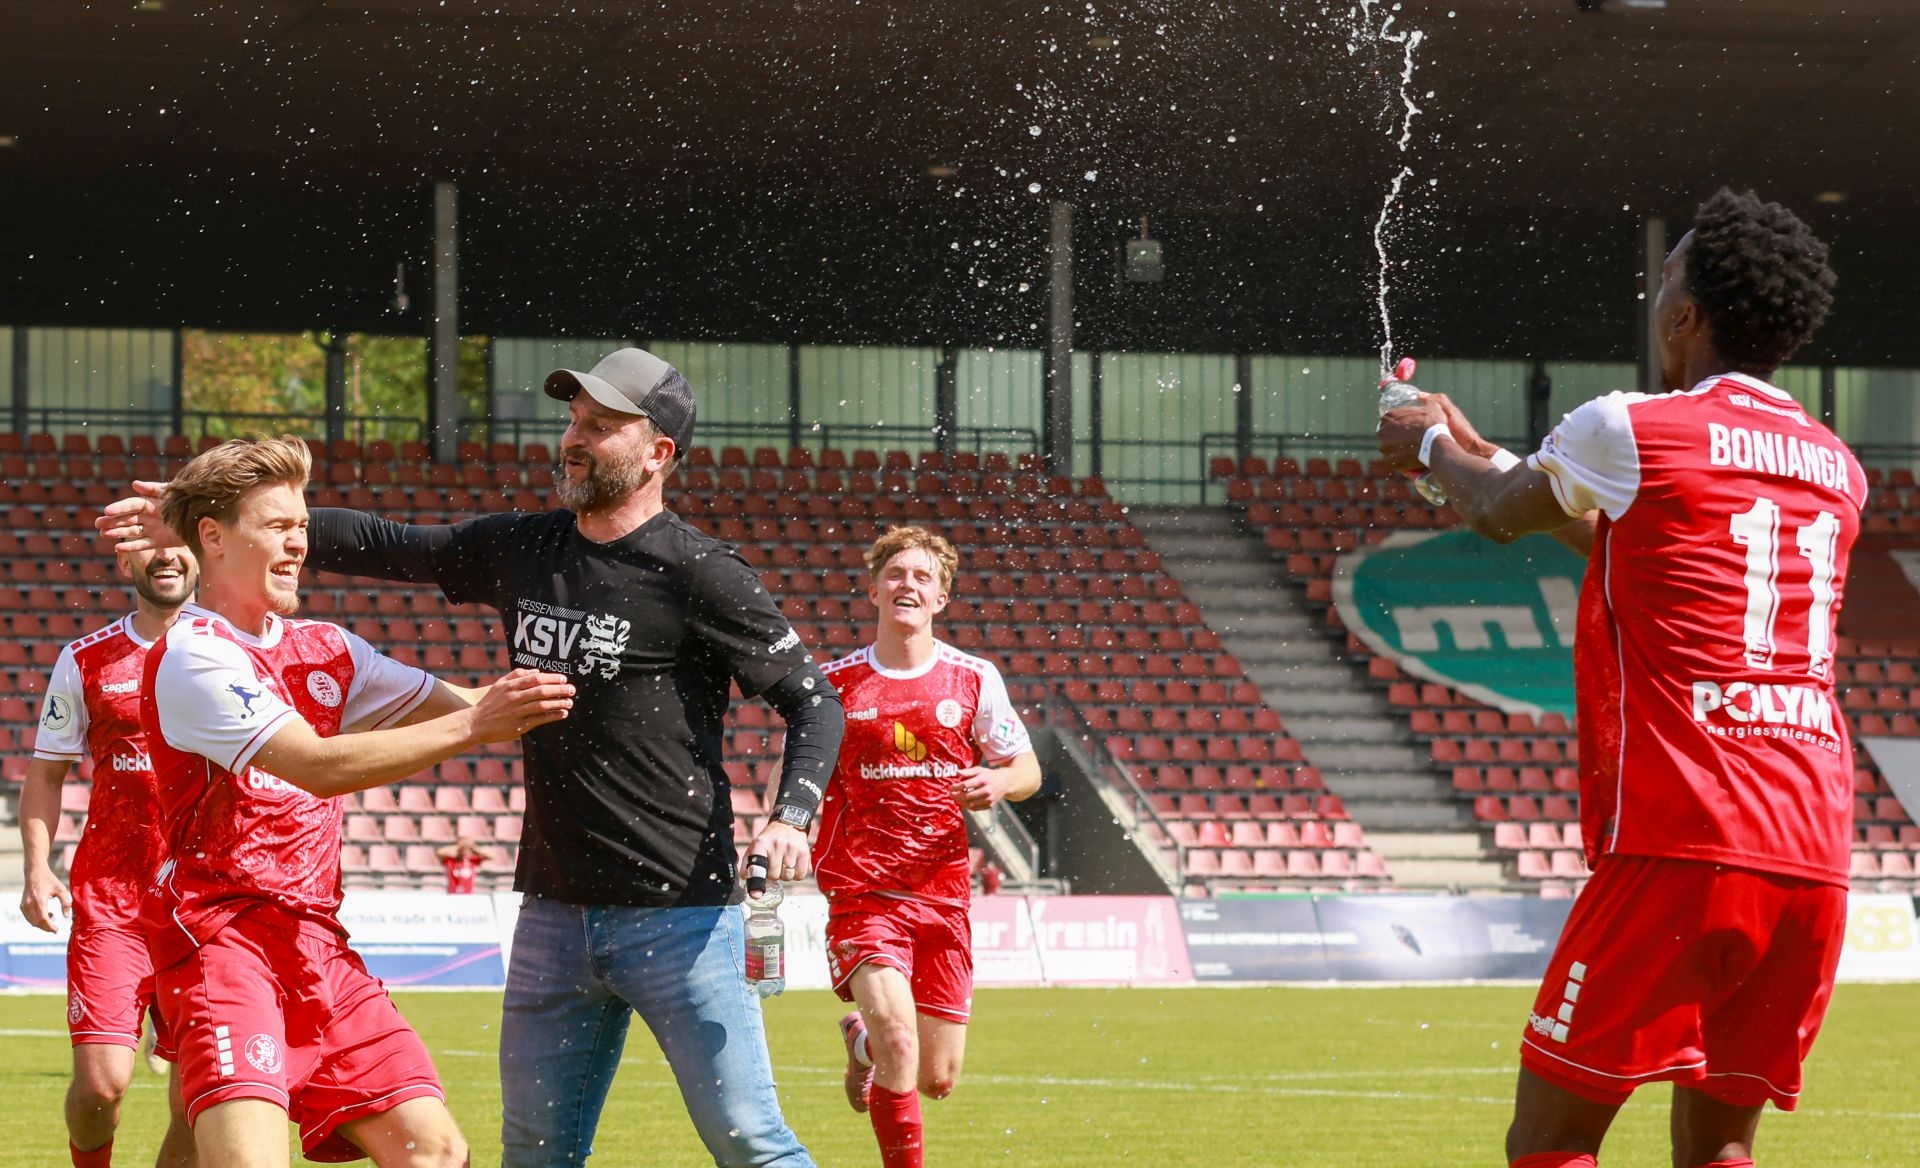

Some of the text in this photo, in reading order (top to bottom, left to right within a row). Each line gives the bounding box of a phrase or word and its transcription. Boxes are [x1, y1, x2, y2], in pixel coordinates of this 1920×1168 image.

[1708, 422, 1850, 494] BONIANGA
[1729, 496, 1840, 680] 11
[517, 597, 555, 616] HESSEN
[514, 611, 581, 660] KSV
[538, 658, 574, 675] KASSEL
[1706, 725, 1817, 745] nergiesysteme
